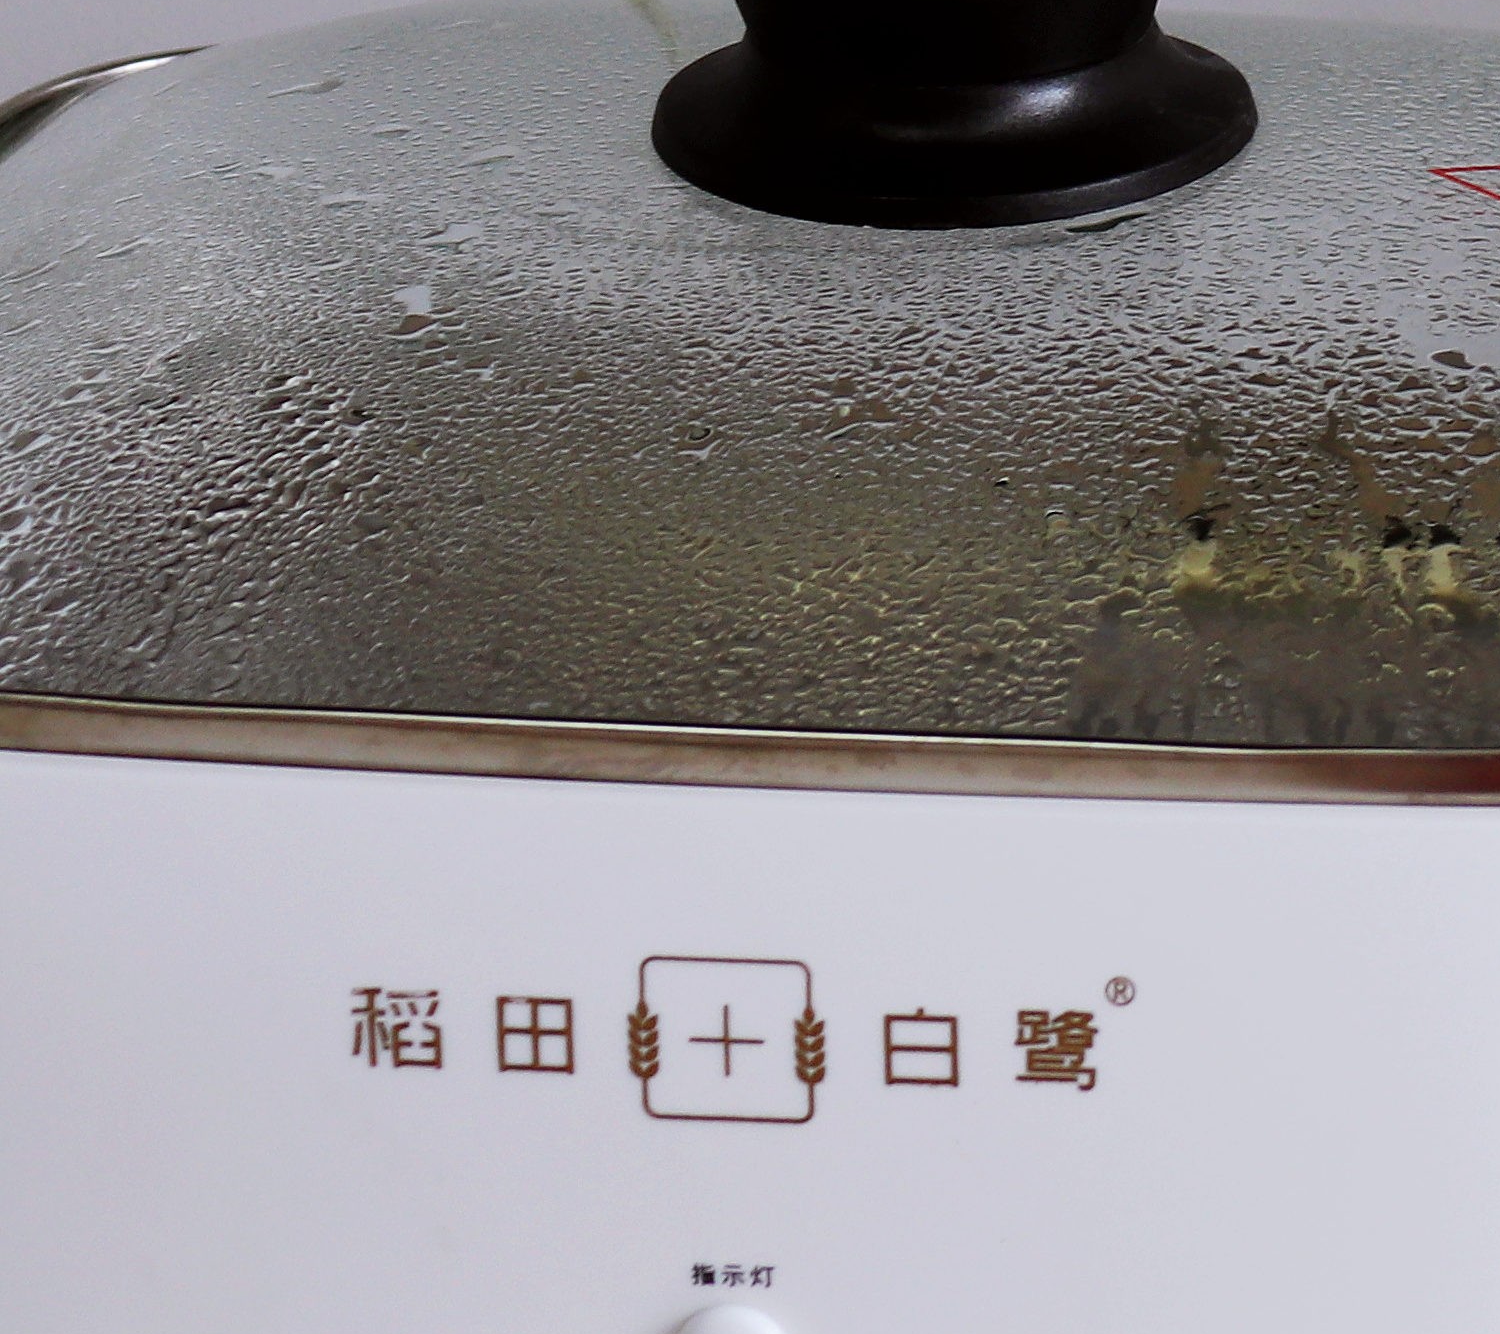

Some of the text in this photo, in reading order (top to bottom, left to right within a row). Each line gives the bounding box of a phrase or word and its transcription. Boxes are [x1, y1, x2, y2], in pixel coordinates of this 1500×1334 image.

[350, 986, 1099, 1092] 稻田 白鹭
[691, 1263, 775, 1288] 指示灯
